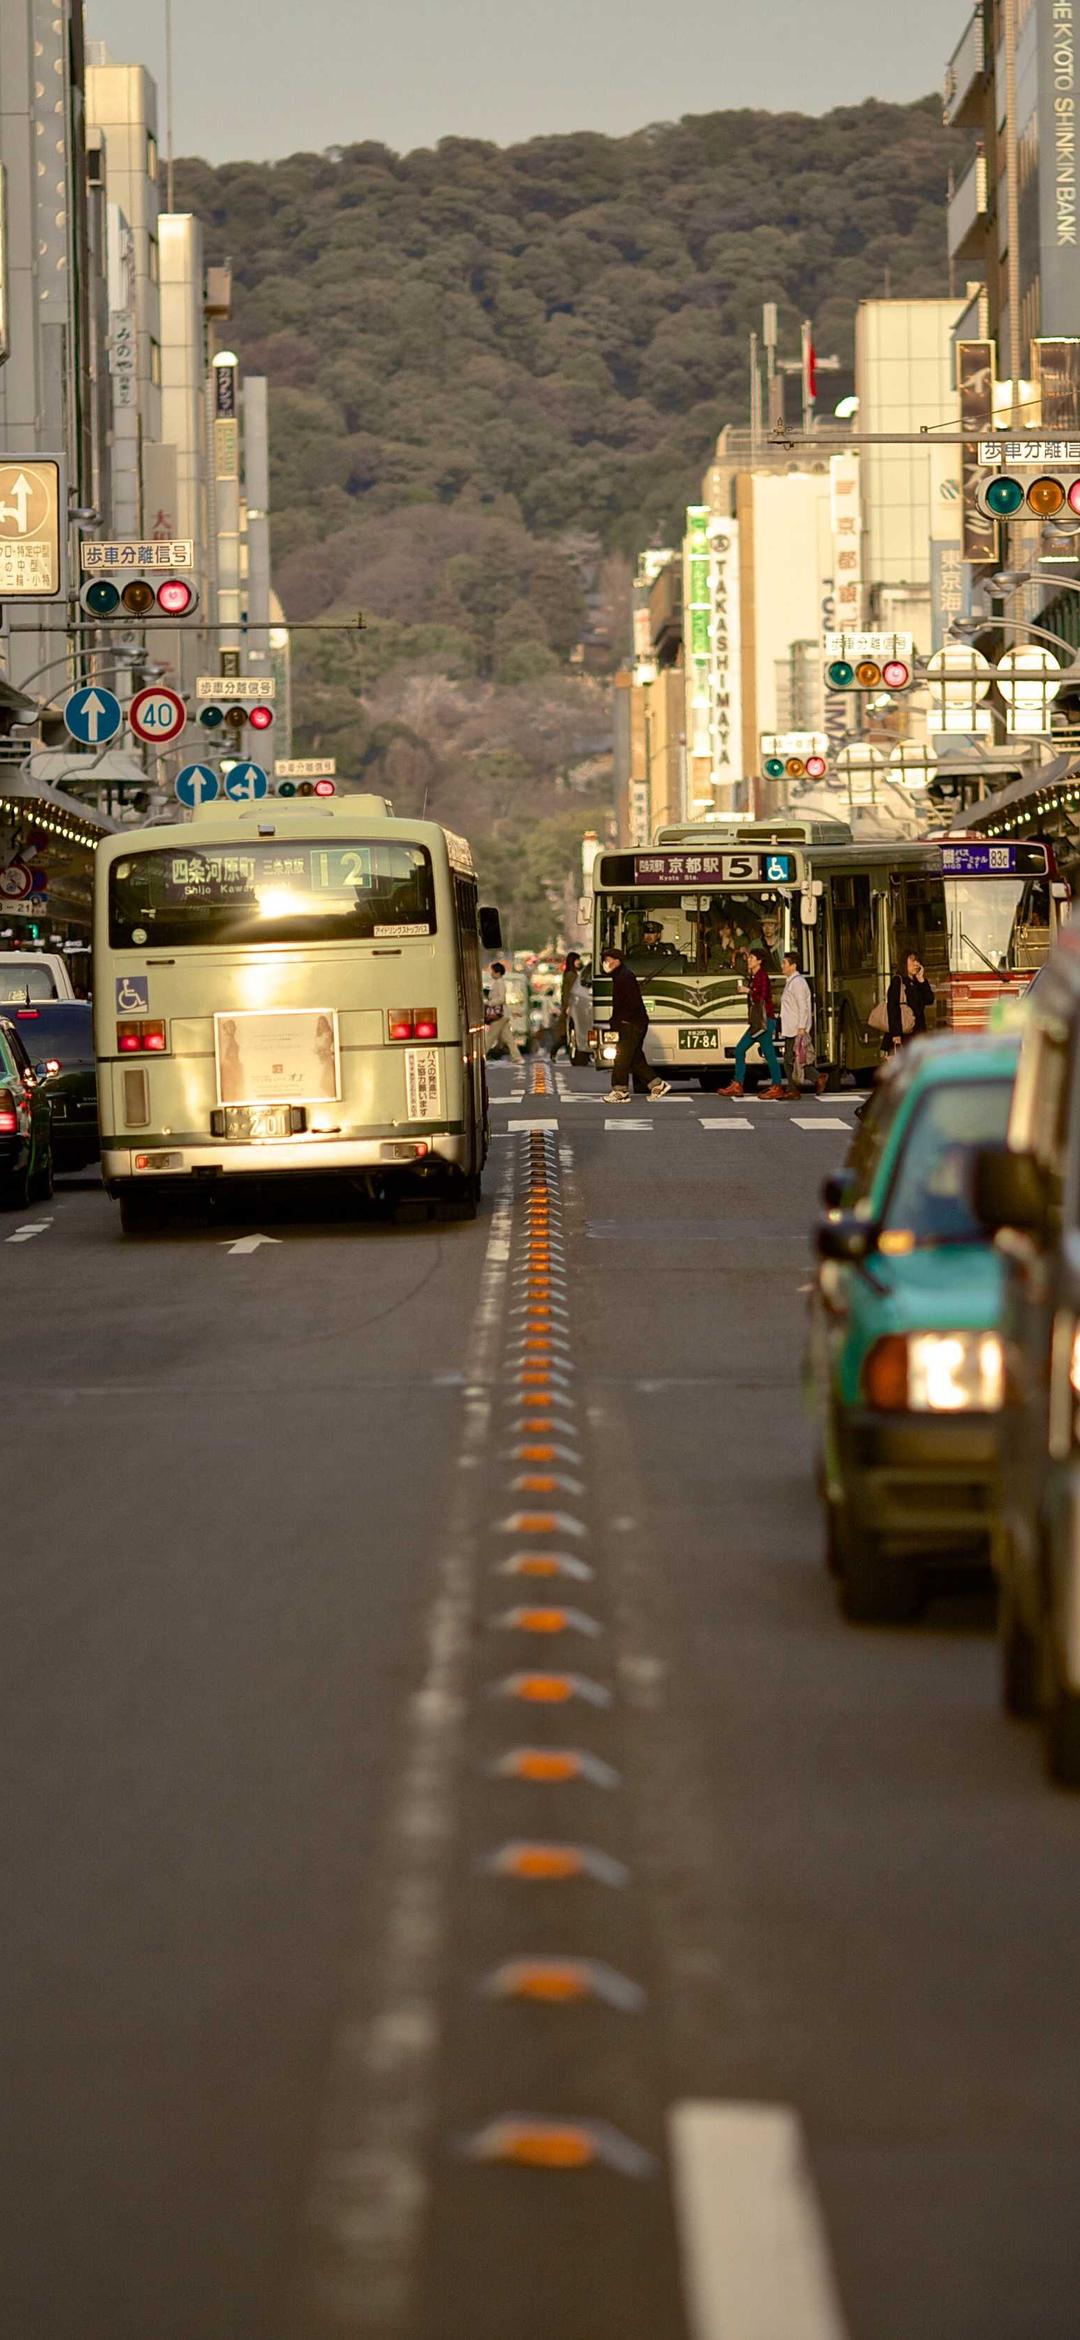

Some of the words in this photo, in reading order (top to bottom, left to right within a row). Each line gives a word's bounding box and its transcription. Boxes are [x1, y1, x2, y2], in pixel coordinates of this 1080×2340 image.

[1054, 23, 1073, 90] KYOTO
[1054, 98, 1075, 182] SHINKIN
[1056, 187, 1076, 245] BANK
[86, 545, 188, 566] 歩車分離信号
[714, 559, 731, 765] TAKASHIMAYA
[201, 681, 271, 696] 歩車分離信号
[143, 704, 173, 727] 40
[172, 857, 256, 884] 四条河原町
[319, 851, 364, 887] 12
[668, 857, 719, 873] 京都駅
[728, 858, 753, 878] 5
[184, 885, 212, 895] Shijo
